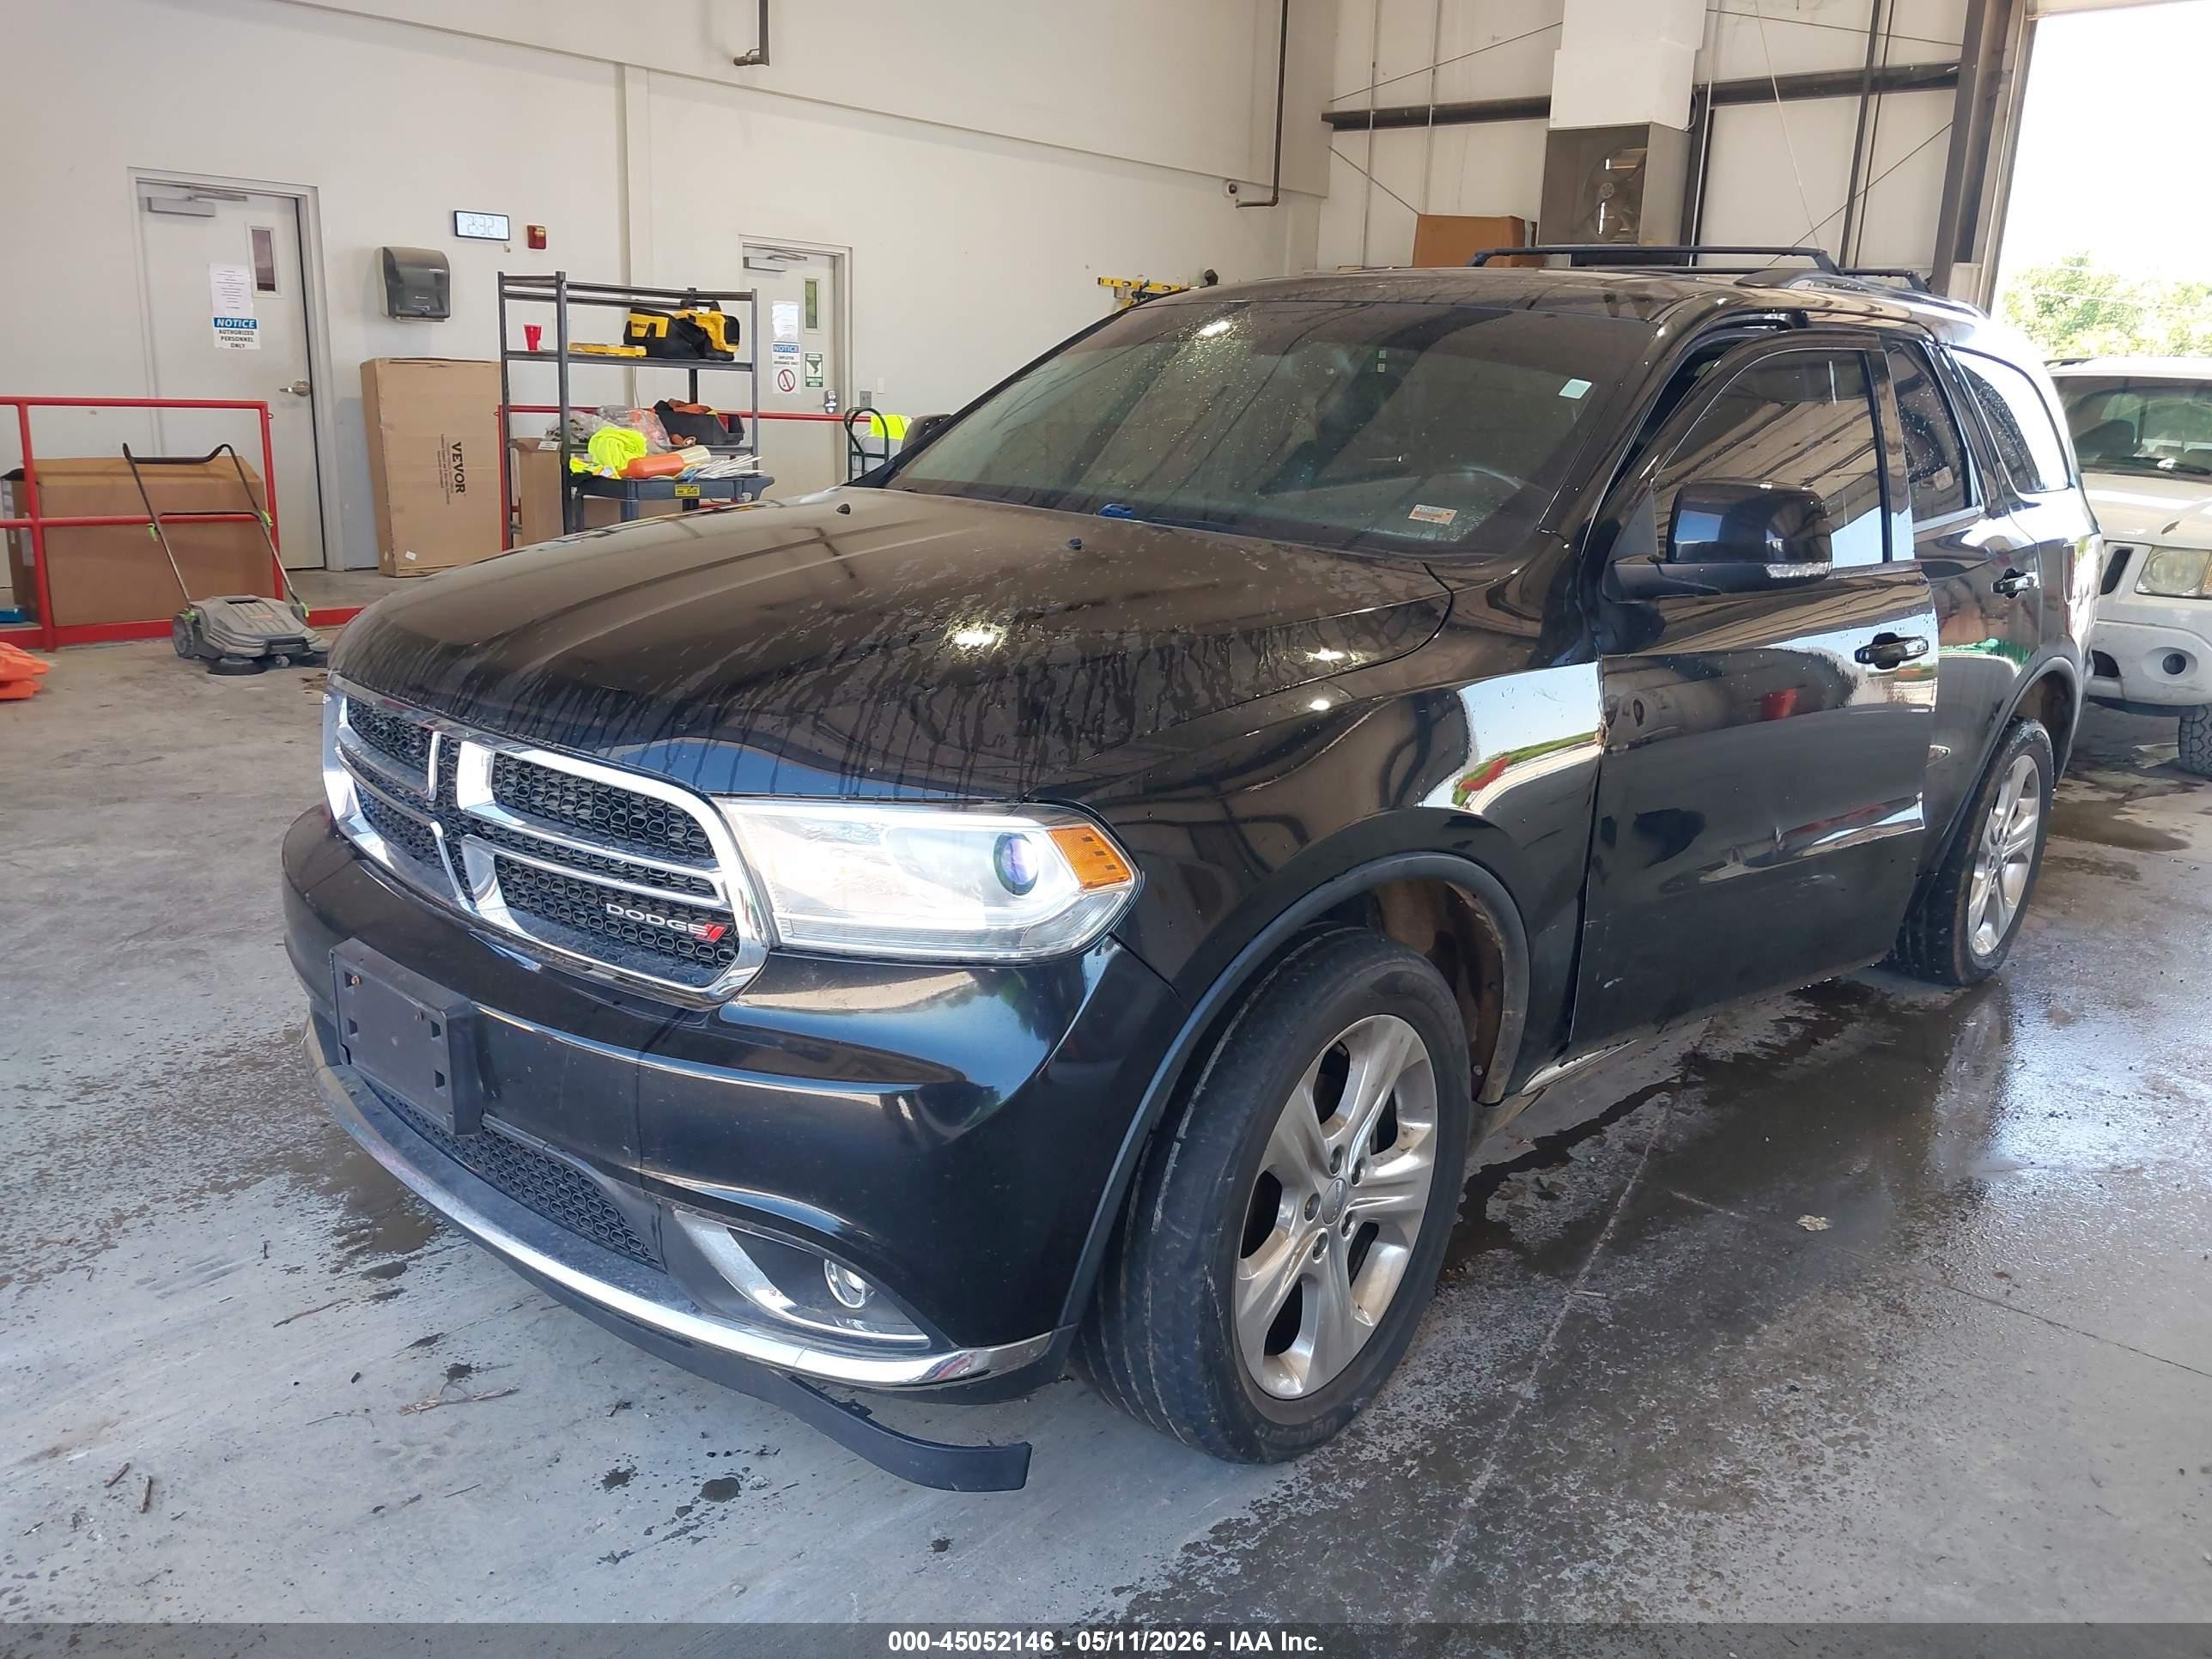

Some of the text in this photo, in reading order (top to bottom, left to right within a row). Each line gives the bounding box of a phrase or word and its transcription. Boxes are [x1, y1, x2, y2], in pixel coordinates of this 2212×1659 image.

[216, 318, 255, 328] NOTICE
[774, 344, 798, 353] NOTICE
[452, 441, 465, 494] VEVOR
[605, 902, 708, 936] DODGE
